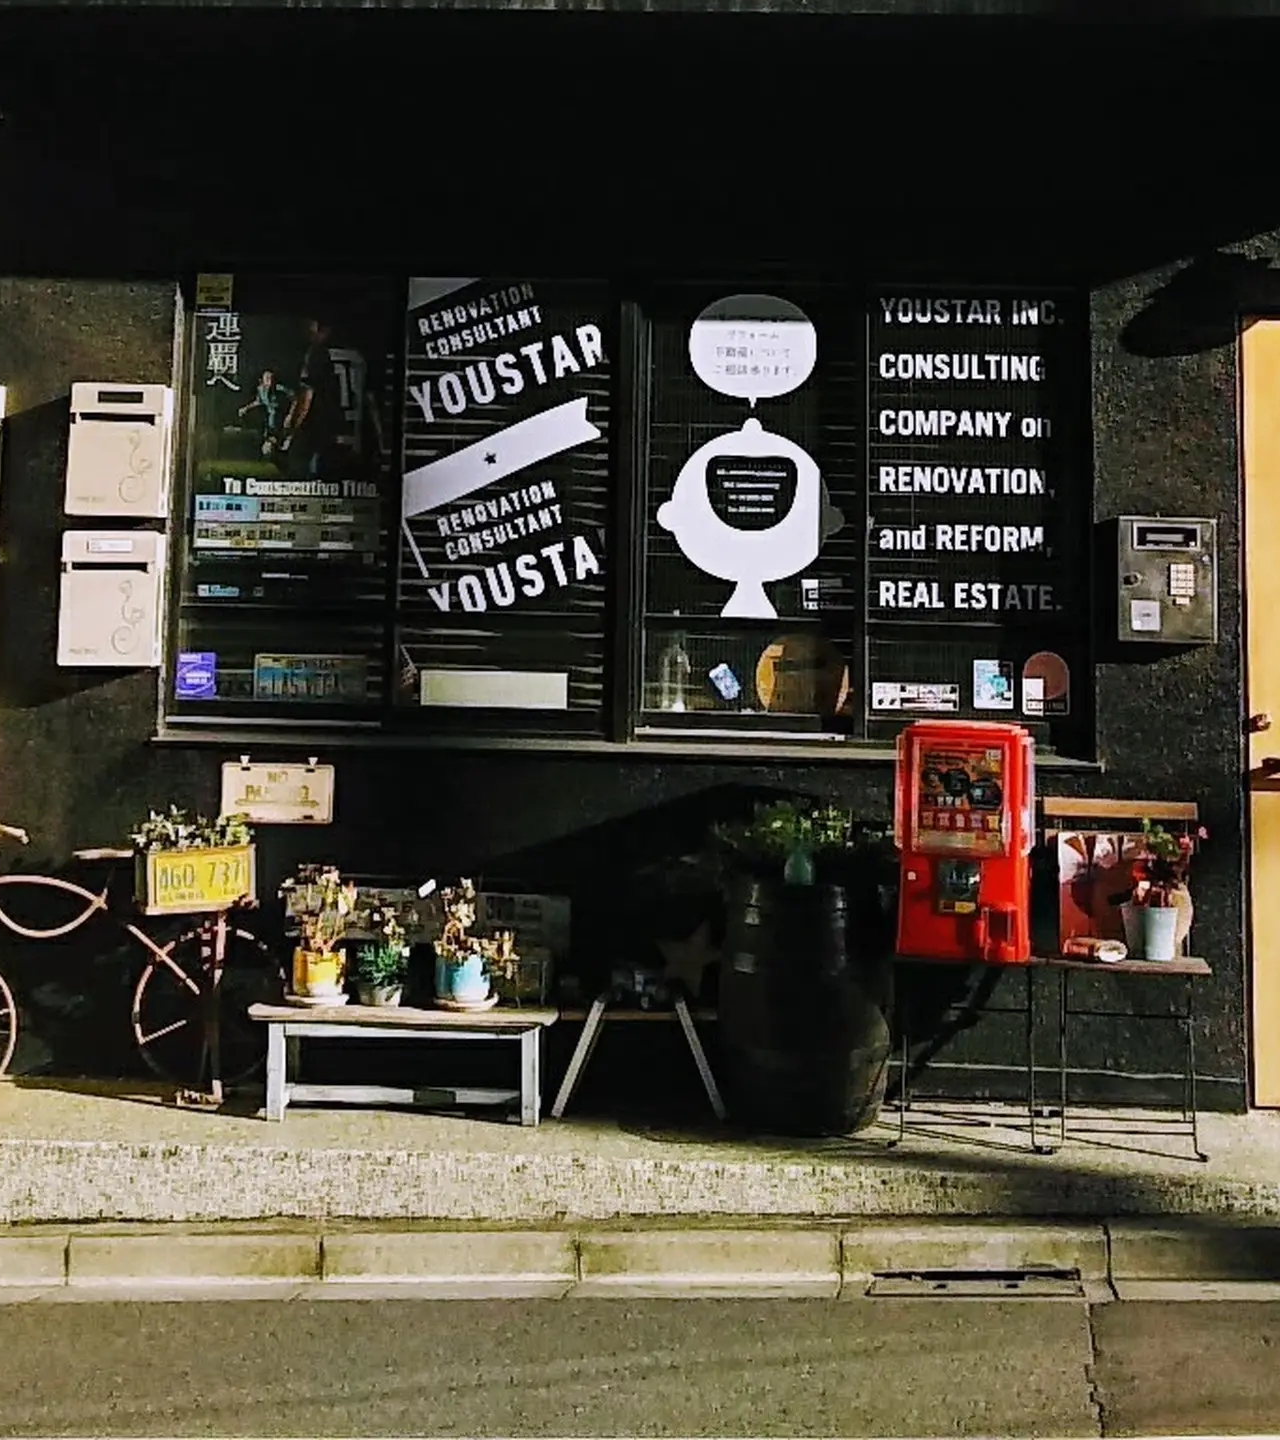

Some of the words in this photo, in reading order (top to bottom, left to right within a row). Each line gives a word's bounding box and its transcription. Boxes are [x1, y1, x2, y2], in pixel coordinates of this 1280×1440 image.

[417, 281, 536, 337] RENOVATION
[879, 297, 1002, 325] YOUSTAR
[1012, 298, 1065, 326] INC.
[425, 304, 543, 360] CONSULTANT
[409, 323, 605, 423] YOUSTAR
[879, 353, 1047, 381] CONSULTING
[879, 409, 1012, 437] COMPANY
[879, 466, 1056, 499] RENOVATION,
[436, 480, 558, 538] RENOVATION
[444, 504, 564, 562] CONSULTANT
[879, 525, 926, 551] and
[427, 534, 601, 613] YOUSTA
[879, 580, 945, 609] REAL
[955, 582, 1063, 611] ESTATE.
